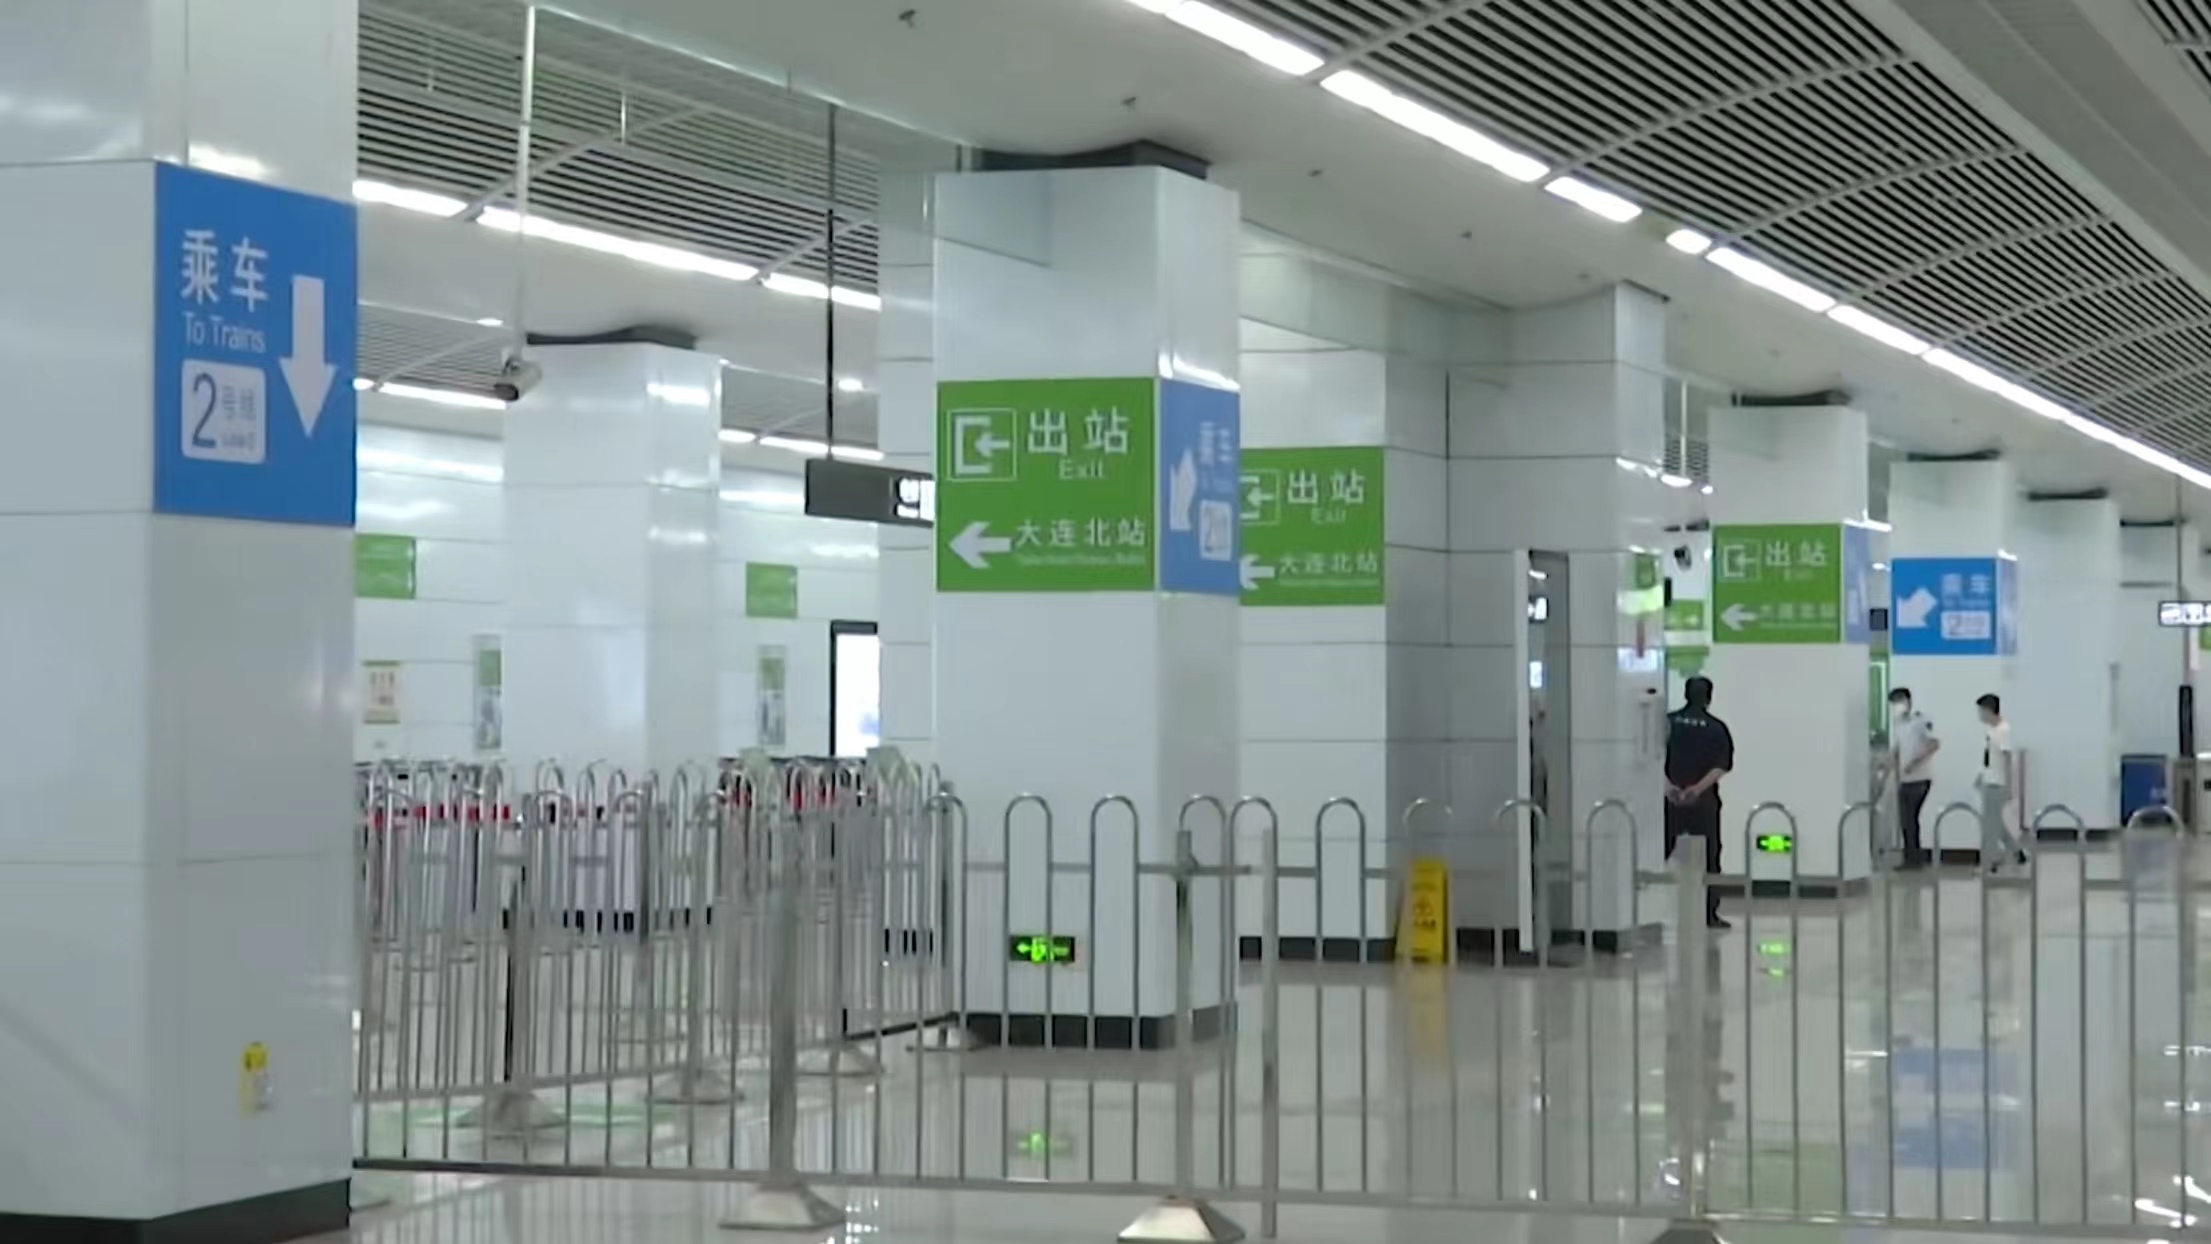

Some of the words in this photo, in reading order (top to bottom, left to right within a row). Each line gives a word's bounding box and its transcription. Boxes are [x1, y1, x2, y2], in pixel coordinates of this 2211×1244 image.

[181, 229, 268, 312] 乘车
[183, 311, 206, 345] To
[210, 316, 265, 353] Trains
[191, 372, 217, 449] 2
[1027, 406, 1129, 455] 出站
[1057, 458, 1105, 480] Exit
[1287, 468, 1366, 504] 出站
[1016, 515, 1146, 547] 大连北站
[1765, 540, 1827, 566] 出站
